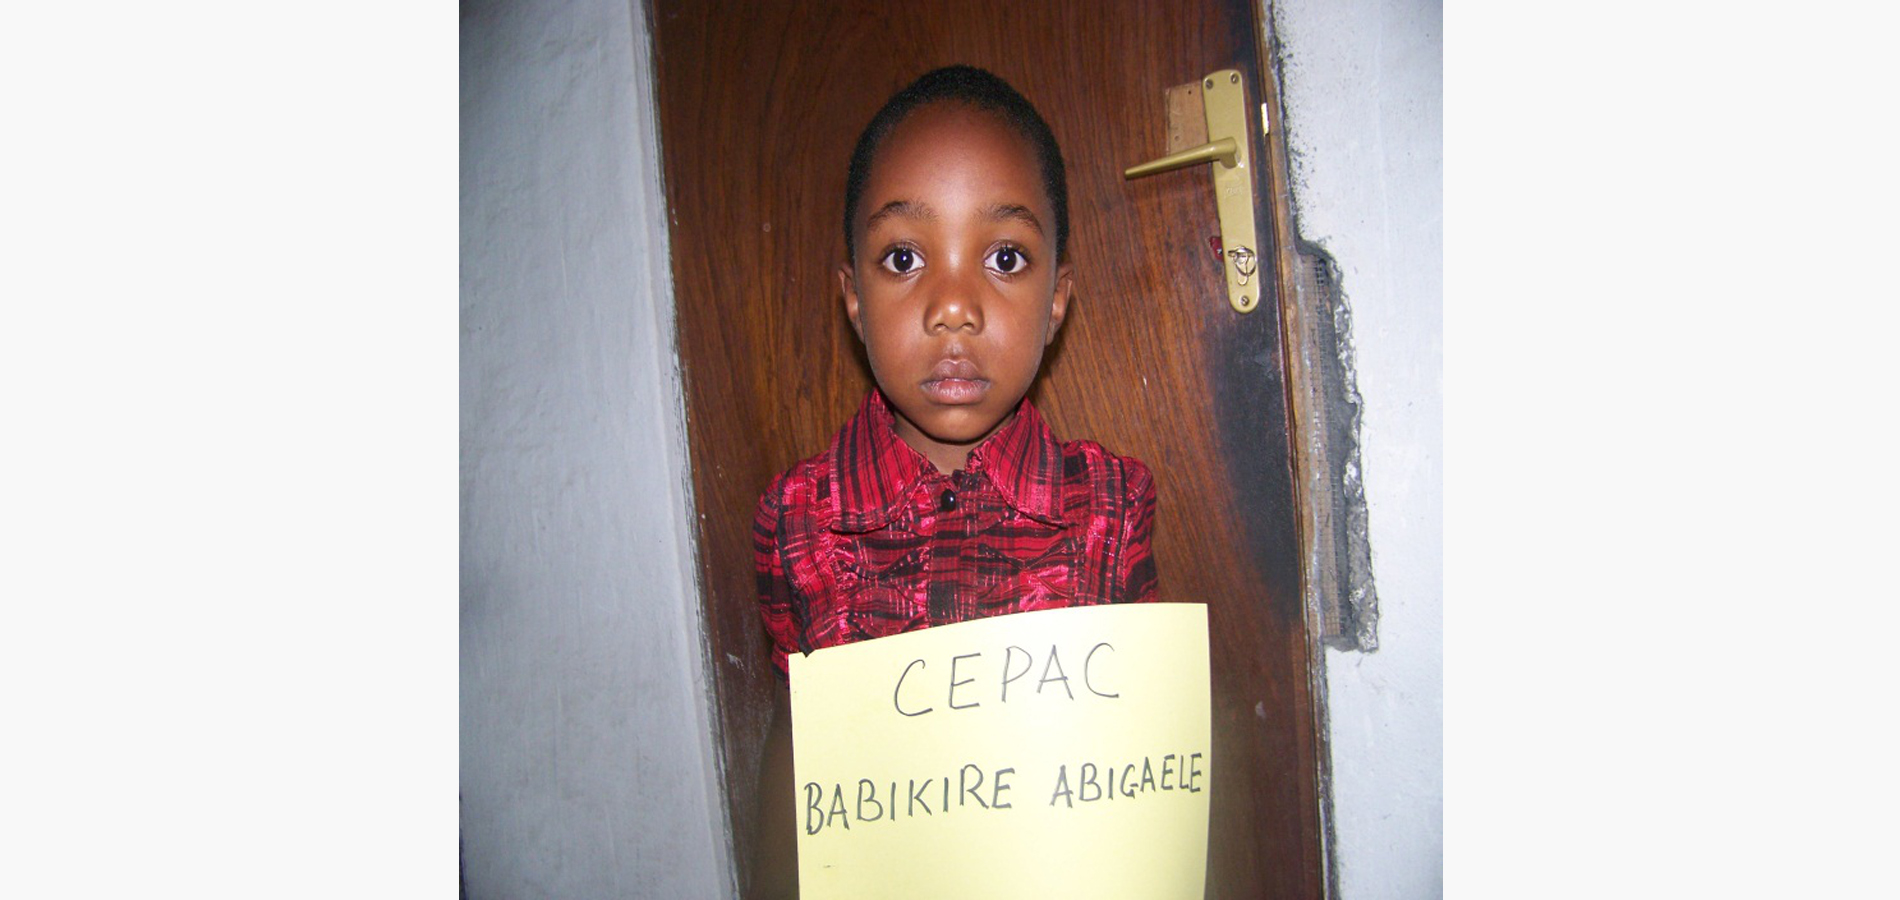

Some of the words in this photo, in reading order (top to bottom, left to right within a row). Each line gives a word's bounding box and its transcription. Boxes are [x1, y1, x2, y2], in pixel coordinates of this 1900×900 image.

[894, 643, 1120, 717] CEPAC
[804, 764, 1015, 836] BABIKIRE
[1049, 752, 1202, 809] ABIGAELE
